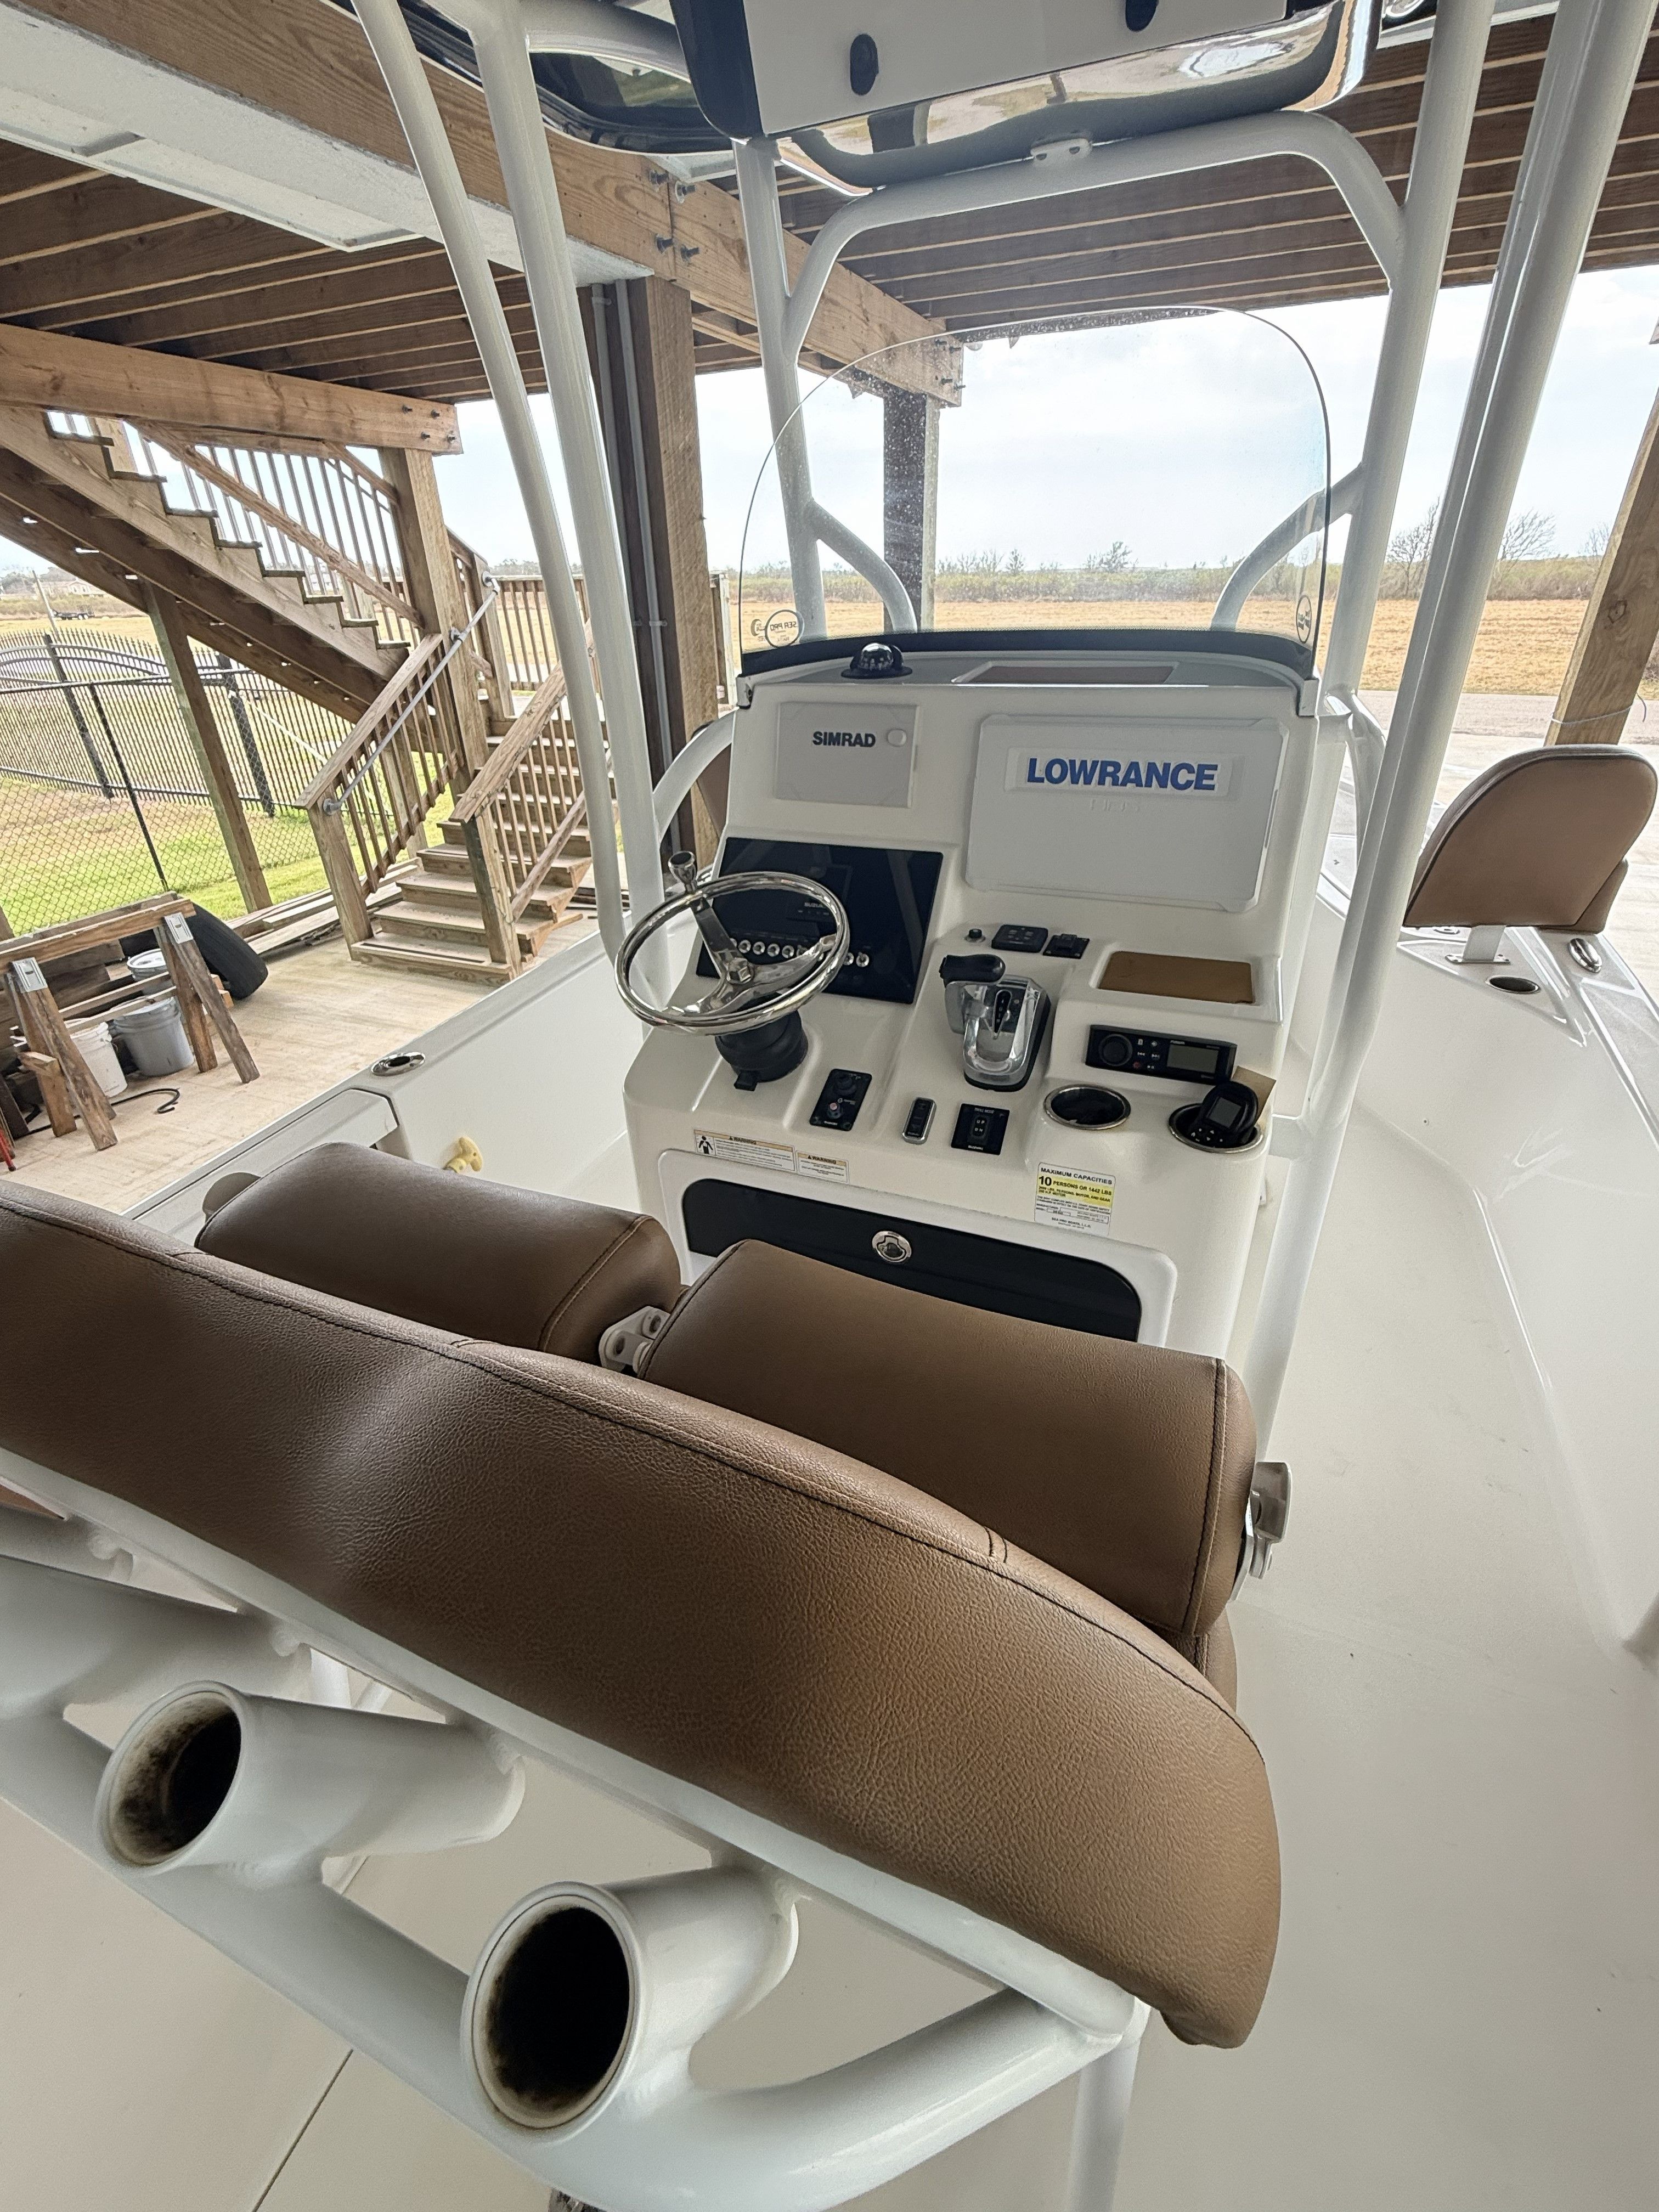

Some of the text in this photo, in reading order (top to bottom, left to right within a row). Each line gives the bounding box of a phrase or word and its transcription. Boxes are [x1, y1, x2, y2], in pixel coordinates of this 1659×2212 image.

[812, 731, 876, 748] SIMRAD
[1028, 758, 1218, 791] LOWRANCE
[733, 1136, 757, 1144] WARNING
[811, 1155, 837, 1164] WARNING
[1039, 1176, 1052, 1186] 10
[1053, 1181, 1078, 1189] PERSONS
[1041, 1167, 1113, 1184] MAXIMUM CAPACITIES
